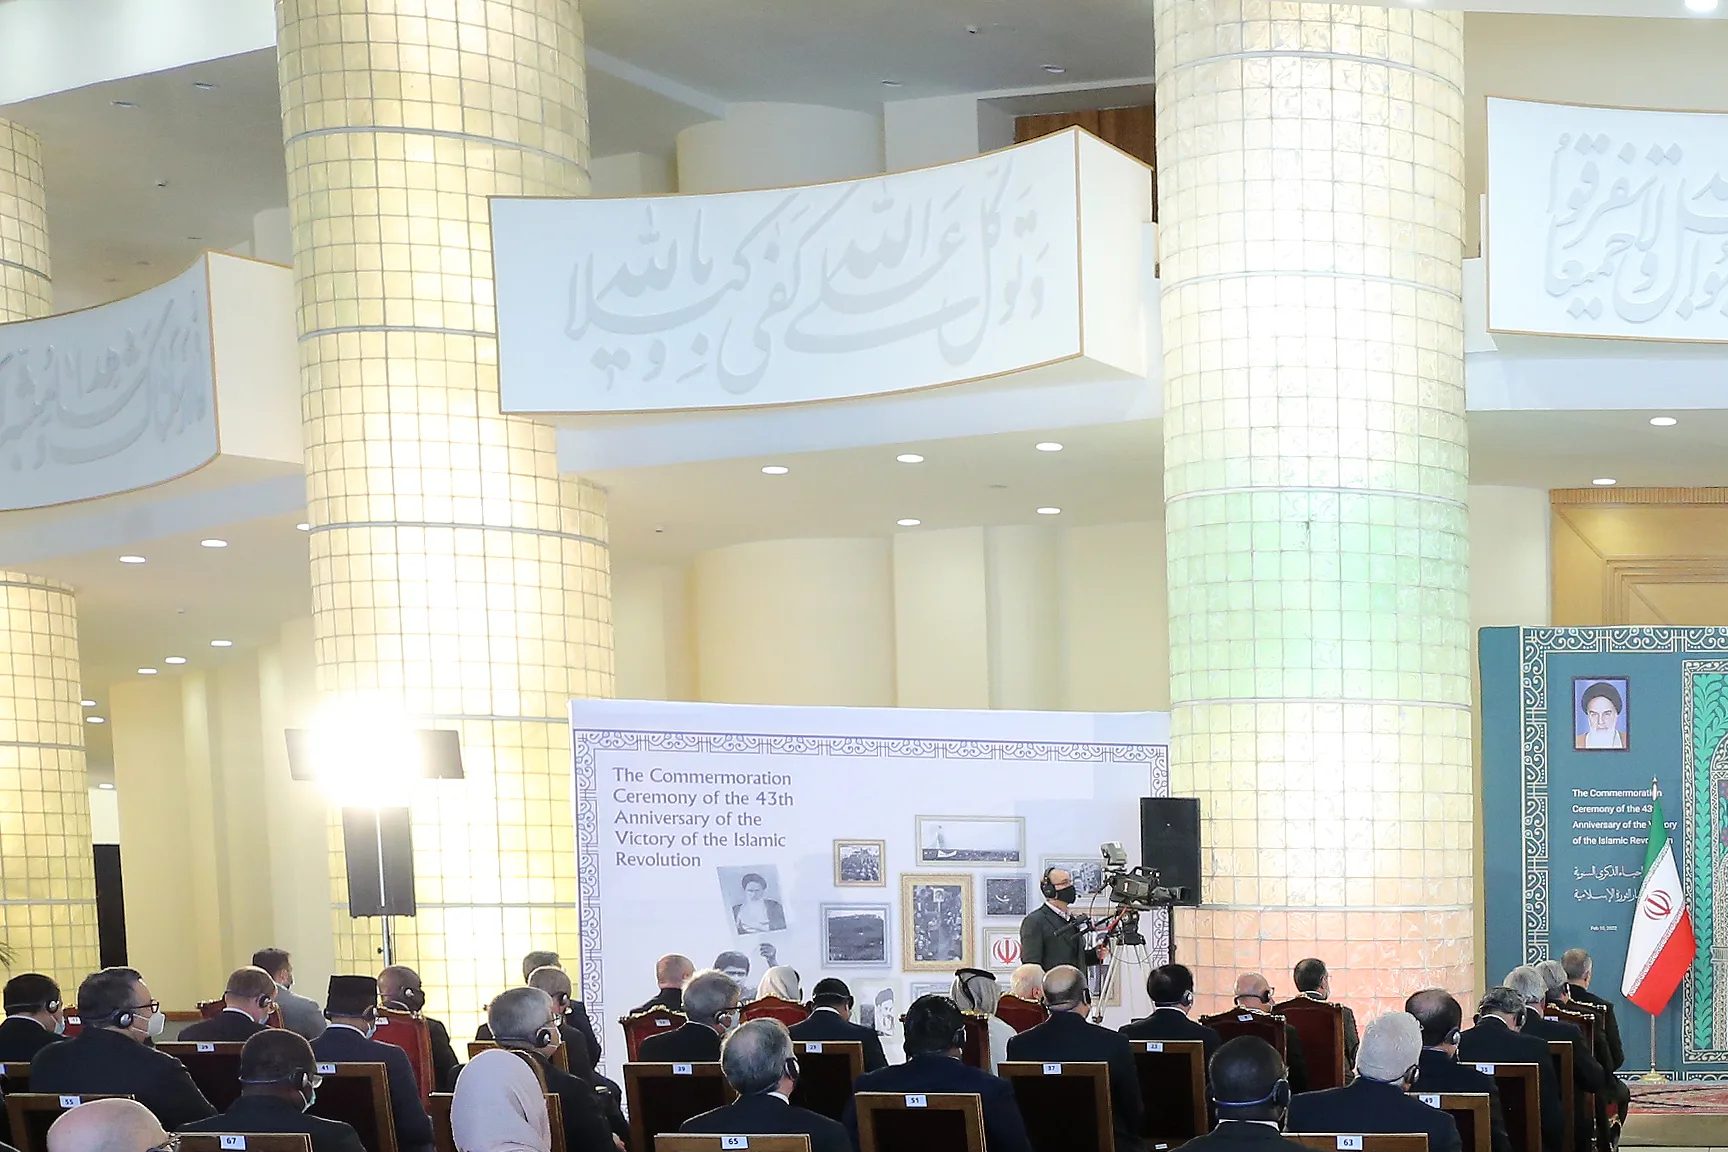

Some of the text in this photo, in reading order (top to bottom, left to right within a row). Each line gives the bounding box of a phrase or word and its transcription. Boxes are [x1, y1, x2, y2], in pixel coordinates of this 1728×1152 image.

[612, 767, 792, 785] The Commermoration
[613, 788, 794, 807] Ceremony of the 43th
[1572, 789, 1588, 797] The
[1572, 805, 1614, 814] Ceremony
[1616, 804, 1625, 813] of
[614, 810, 762, 828] Anniversary of the
[1572, 821, 1621, 830] Anniversary
[1622, 820, 1632, 828] of
[615, 831, 786, 848] Victory of the Islamic
[1572, 836, 1582, 844] of
[616, 851, 701, 867] Revolution
